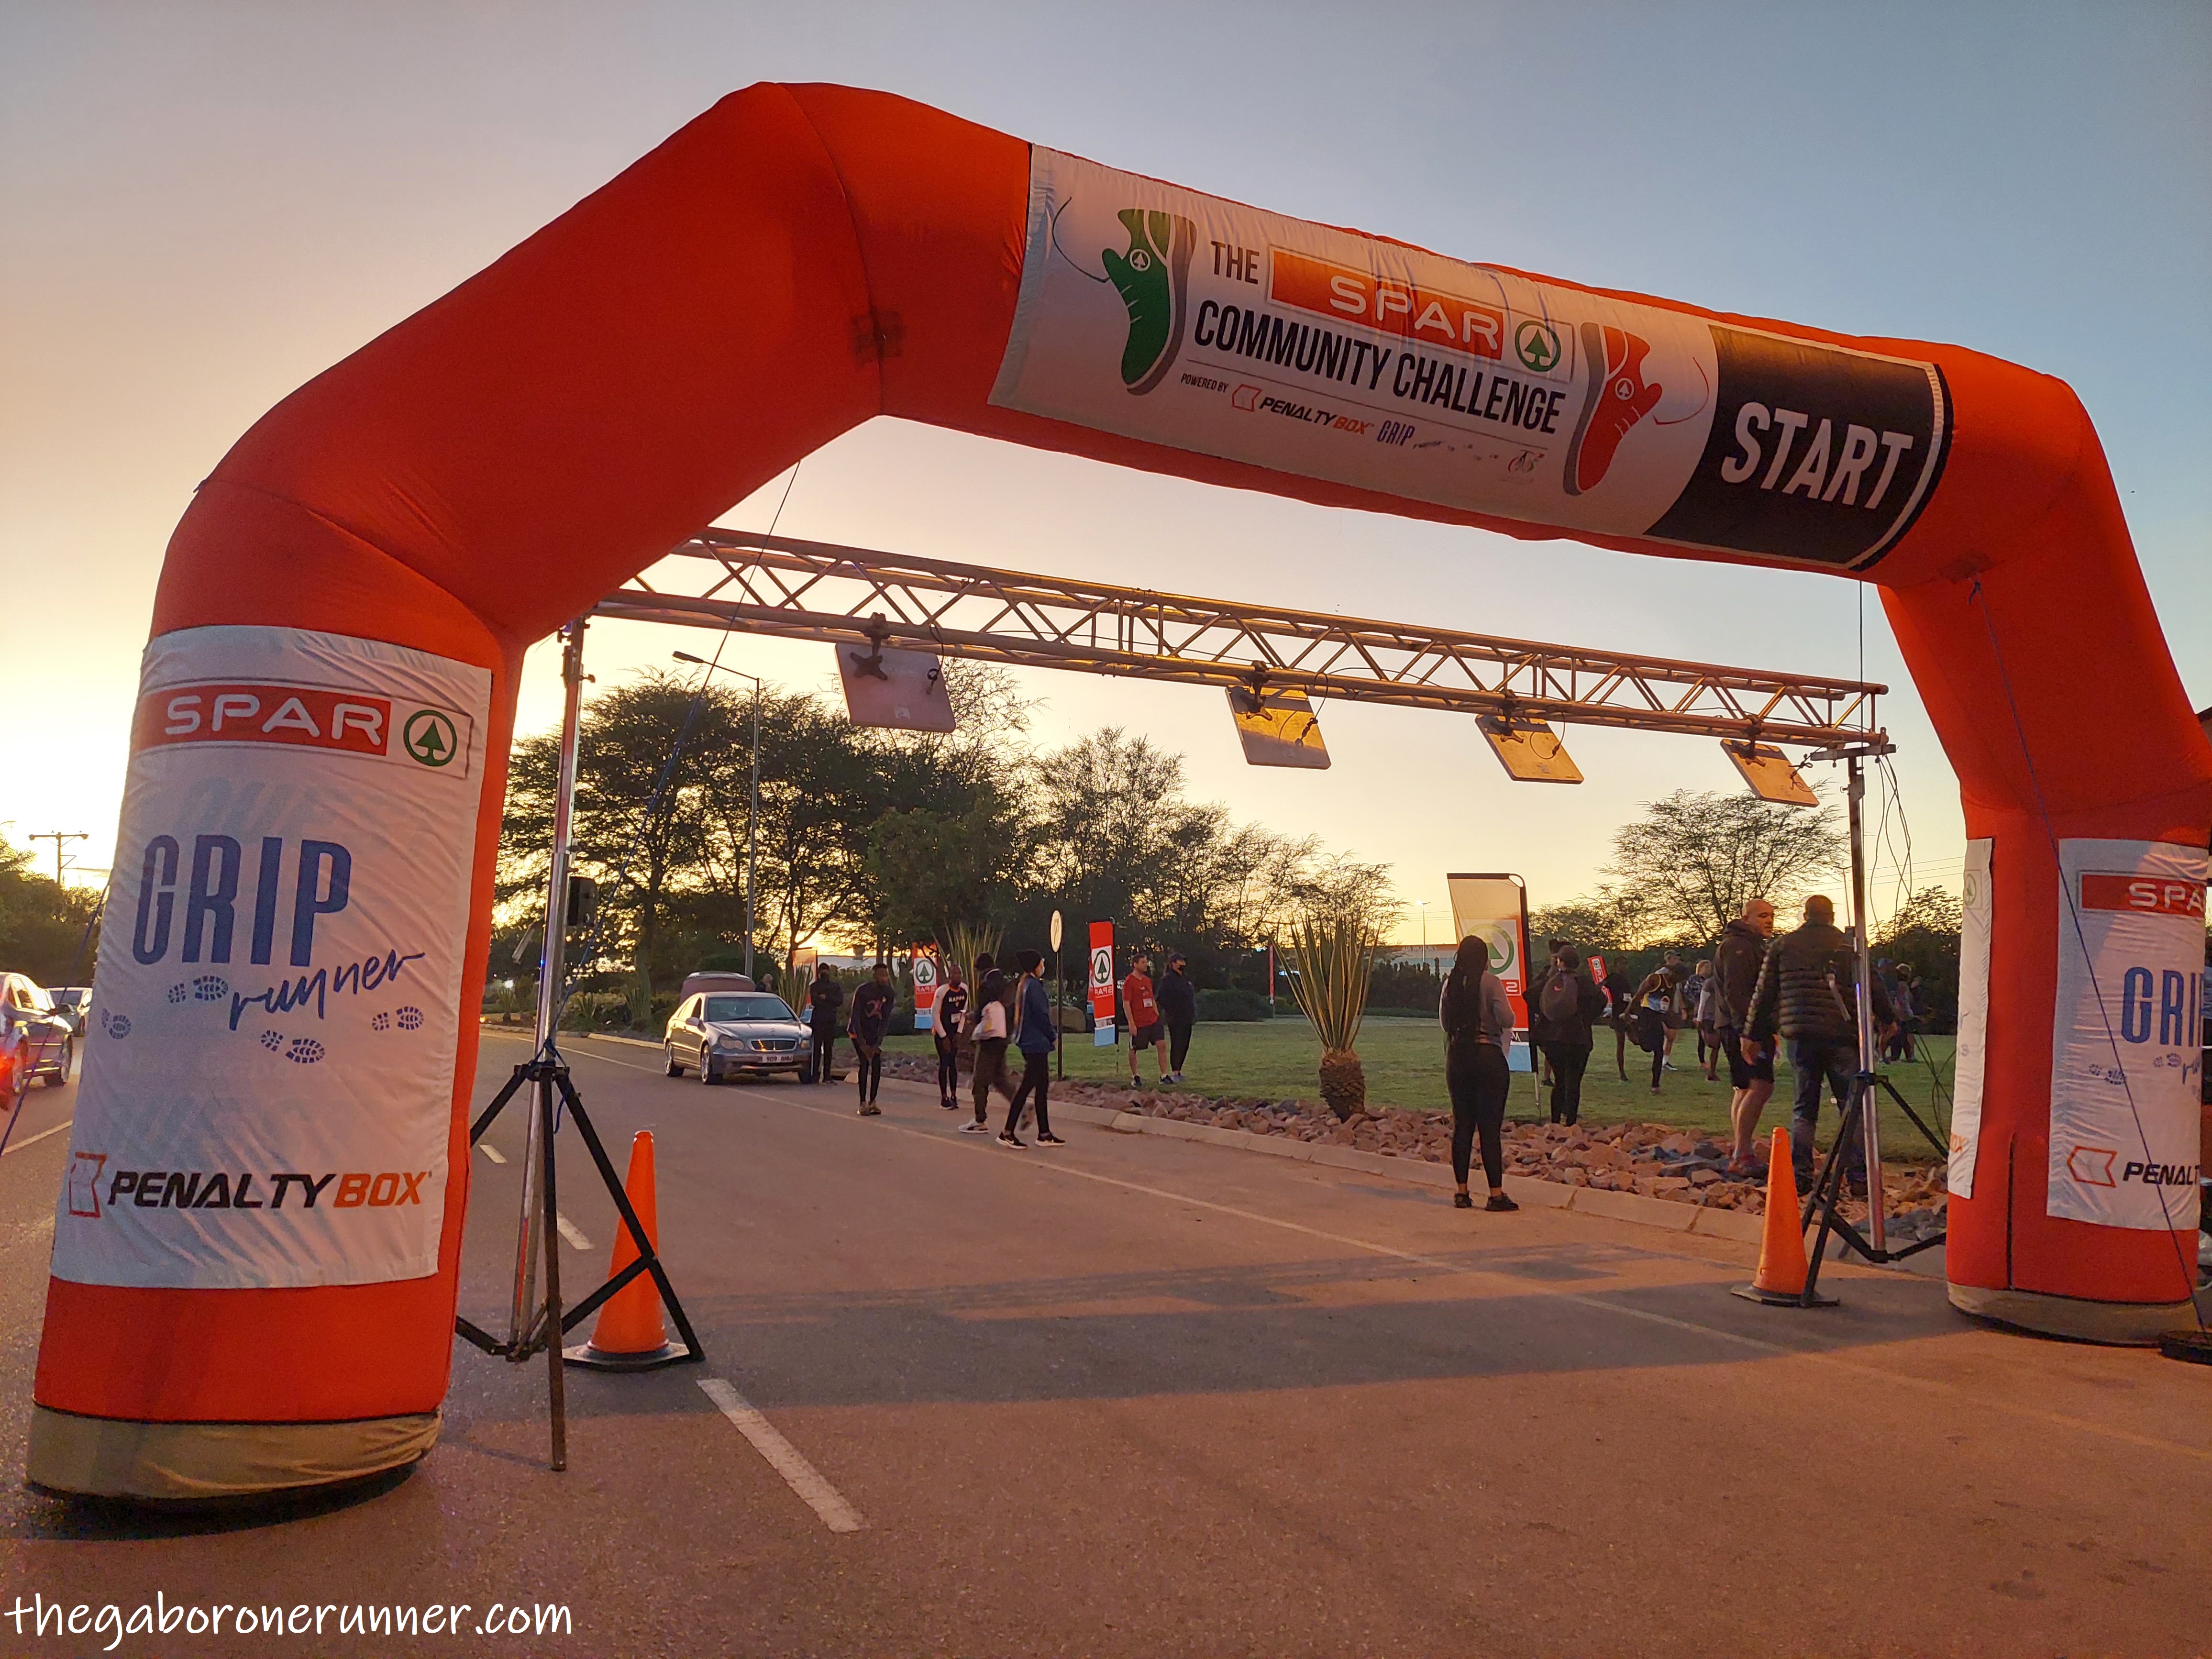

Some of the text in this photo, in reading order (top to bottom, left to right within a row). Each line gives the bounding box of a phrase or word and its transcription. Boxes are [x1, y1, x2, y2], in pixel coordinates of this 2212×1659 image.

[1210, 241, 1498, 351] THE SPAR
[1181, 373, 1229, 393] POWERED BY
[1194, 300, 1566, 434] COMMUNITY CHALLENGE
[1376, 420, 1416, 447] GRIP
[1721, 401, 1913, 509] START
[165, 693, 383, 746] SPAR
[132, 834, 352, 967] GRIP
[2129, 882, 2205, 912] SPA
[229, 949, 426, 1031] runner
